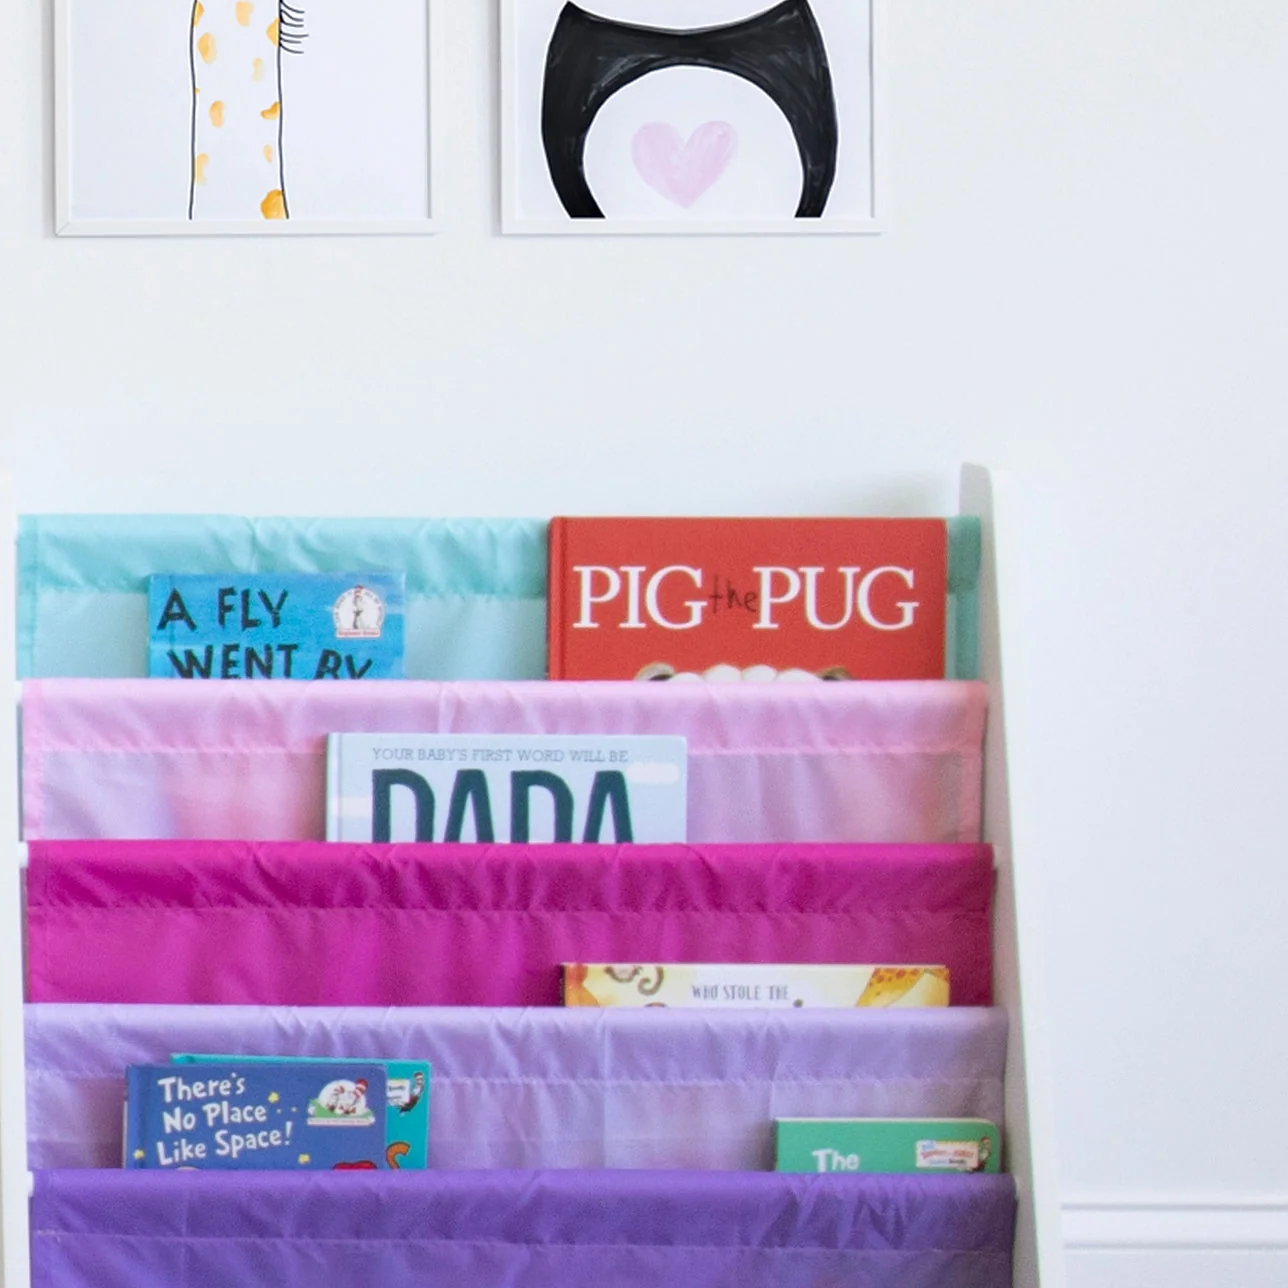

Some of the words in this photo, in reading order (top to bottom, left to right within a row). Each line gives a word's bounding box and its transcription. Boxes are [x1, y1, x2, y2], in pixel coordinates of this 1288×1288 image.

[157, 587, 197, 631] A
[217, 586, 289, 631] FLY
[572, 565, 708, 630] PIG
[708, 574, 758, 614] the
[752, 566, 919, 630] PUG
[166, 642, 299, 679] WENT
[372, 748, 414, 761] YOUR
[418, 748, 468, 762] BABY'S
[472, 749, 512, 762] FIRST
[517, 749, 564, 762] WORD
[568, 749, 606, 762] WILL
[609, 750, 629, 762] BE
[372, 768, 634, 844] DADA
[691, 985, 718, 1000] WHO
[723, 985, 761, 1000] STOLE
[768, 985, 789, 1000] THE
[157, 1072, 245, 1103] There's
[163, 1107, 196, 1134] No
[202, 1100, 267, 1127] Place
[156, 1138, 206, 1166] Like
[215, 1120, 293, 1158] Space!
[812, 1148, 860, 1172] The
